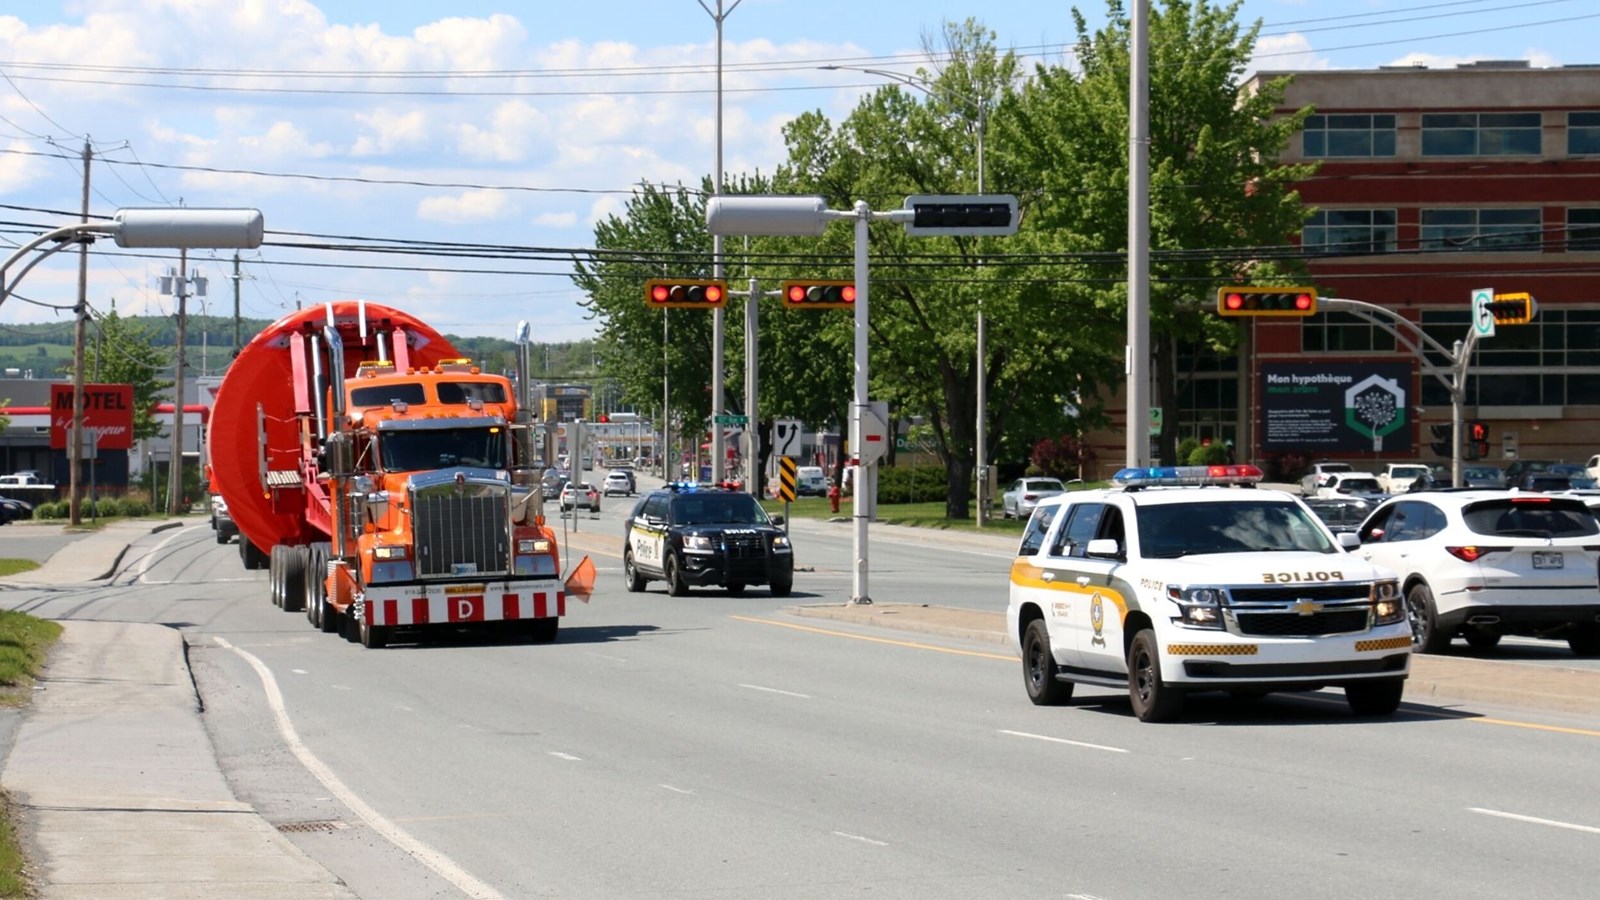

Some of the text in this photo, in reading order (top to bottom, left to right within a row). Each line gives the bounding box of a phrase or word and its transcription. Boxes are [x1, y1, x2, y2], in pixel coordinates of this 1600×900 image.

[1267, 373, 1353, 385] Mon hypothèque
[636, 538, 652, 559] Police
[1140, 577, 1164, 591] POLICE
[459, 600, 473, 619] D
